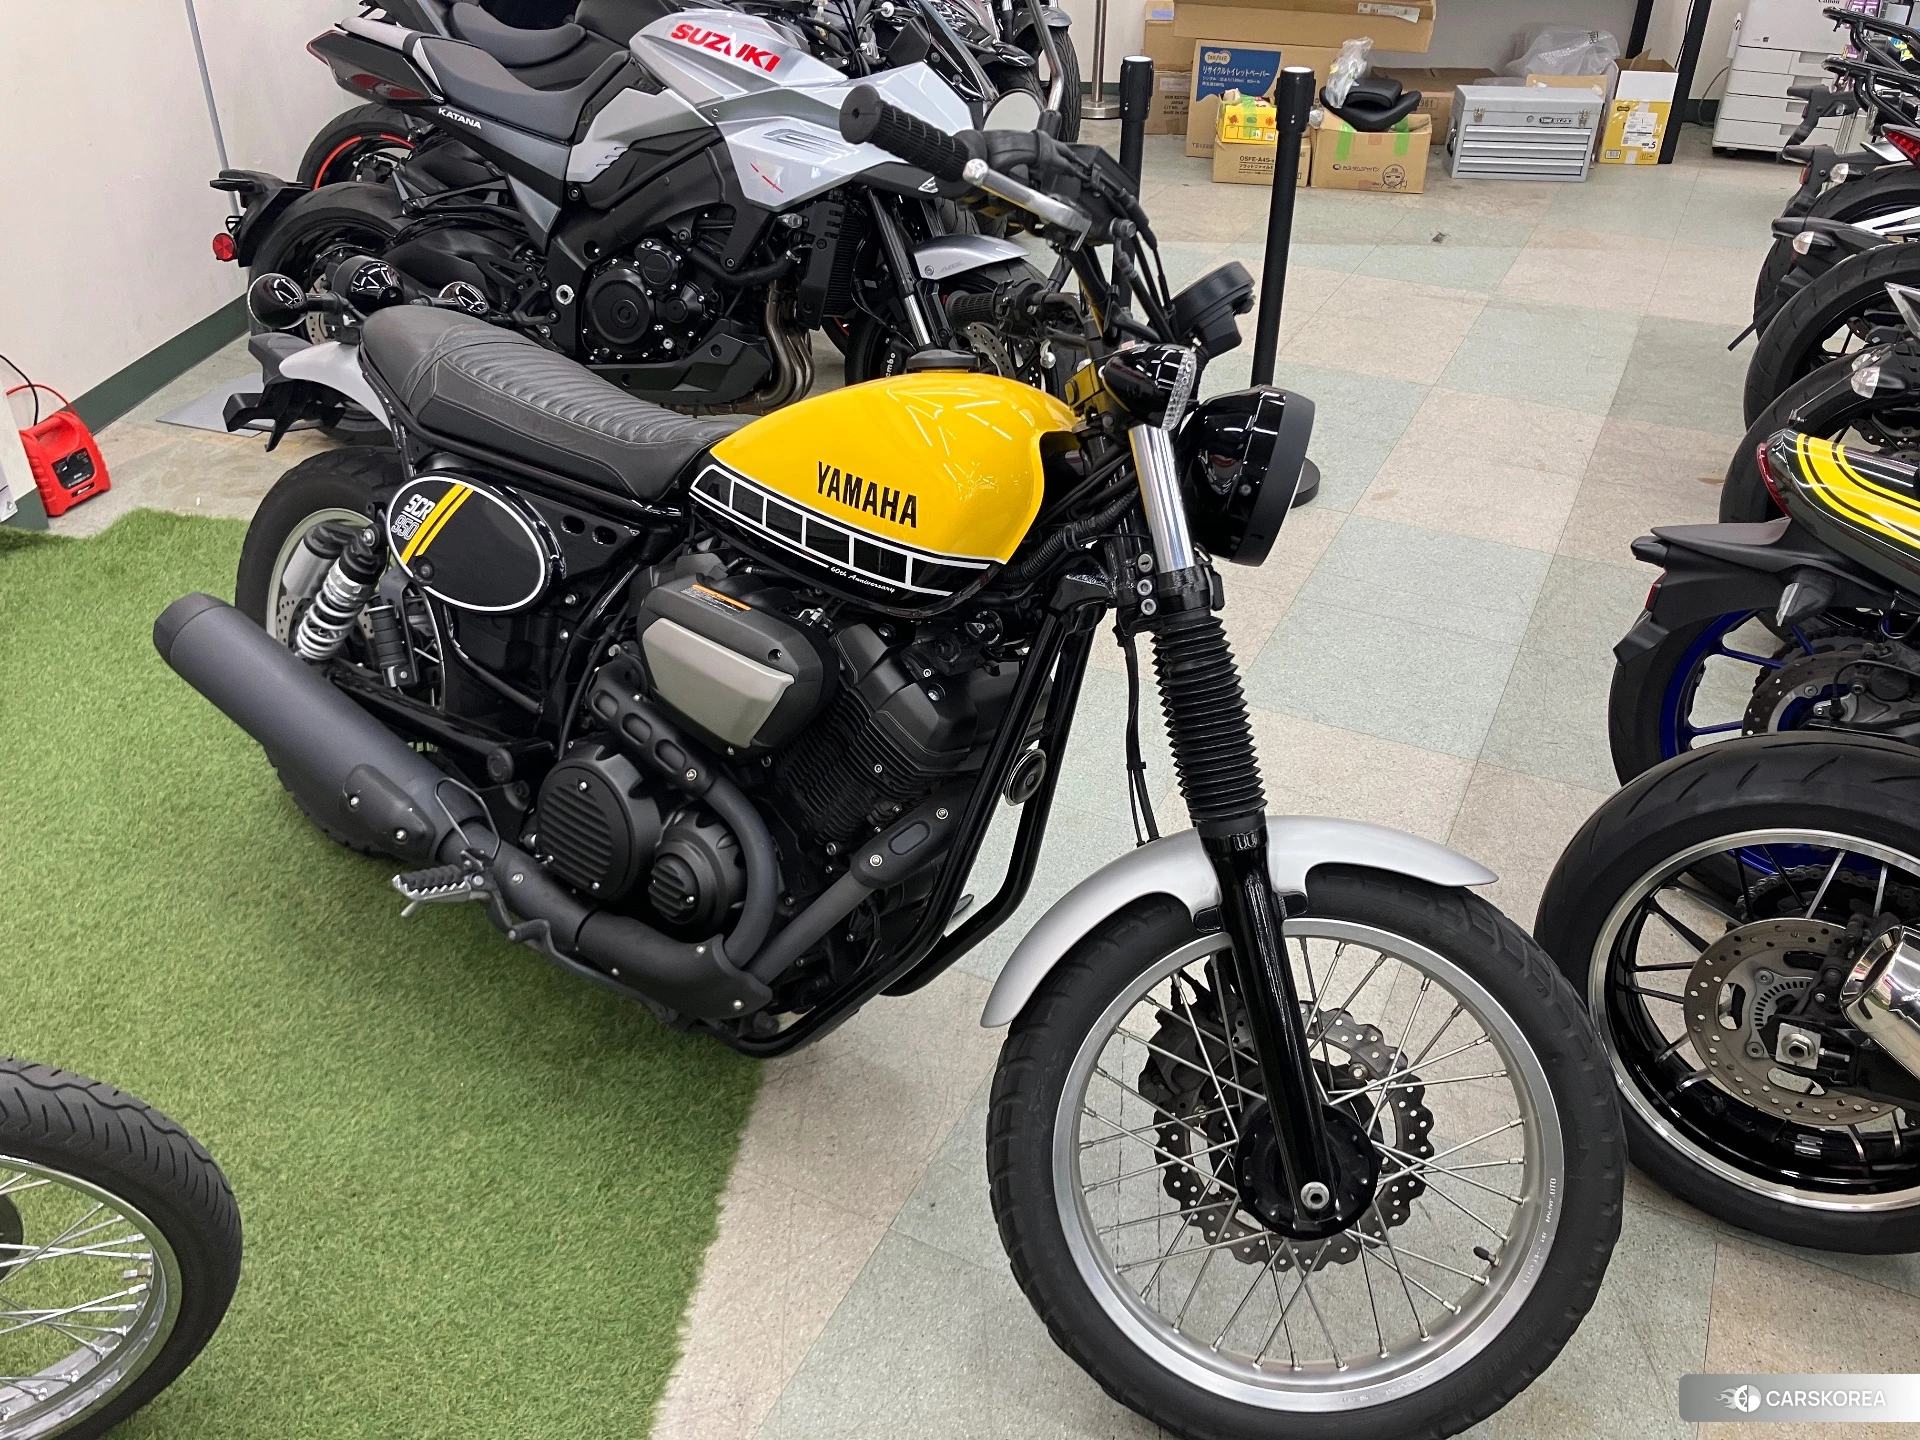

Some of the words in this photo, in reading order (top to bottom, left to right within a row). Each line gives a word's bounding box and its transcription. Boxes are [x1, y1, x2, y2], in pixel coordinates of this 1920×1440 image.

[670, 24, 781, 72] SUZUKI
[1203, 66, 1270, 77] リサイクルトイレットペーパー
[438, 107, 482, 130] KATANA
[403, 493, 436, 521] SCR
[817, 460, 917, 529] YAMAHA
[390, 514, 420, 541] 950
[830, 566, 847, 577] 60th
[848, 574, 896, 593] Anniversary
